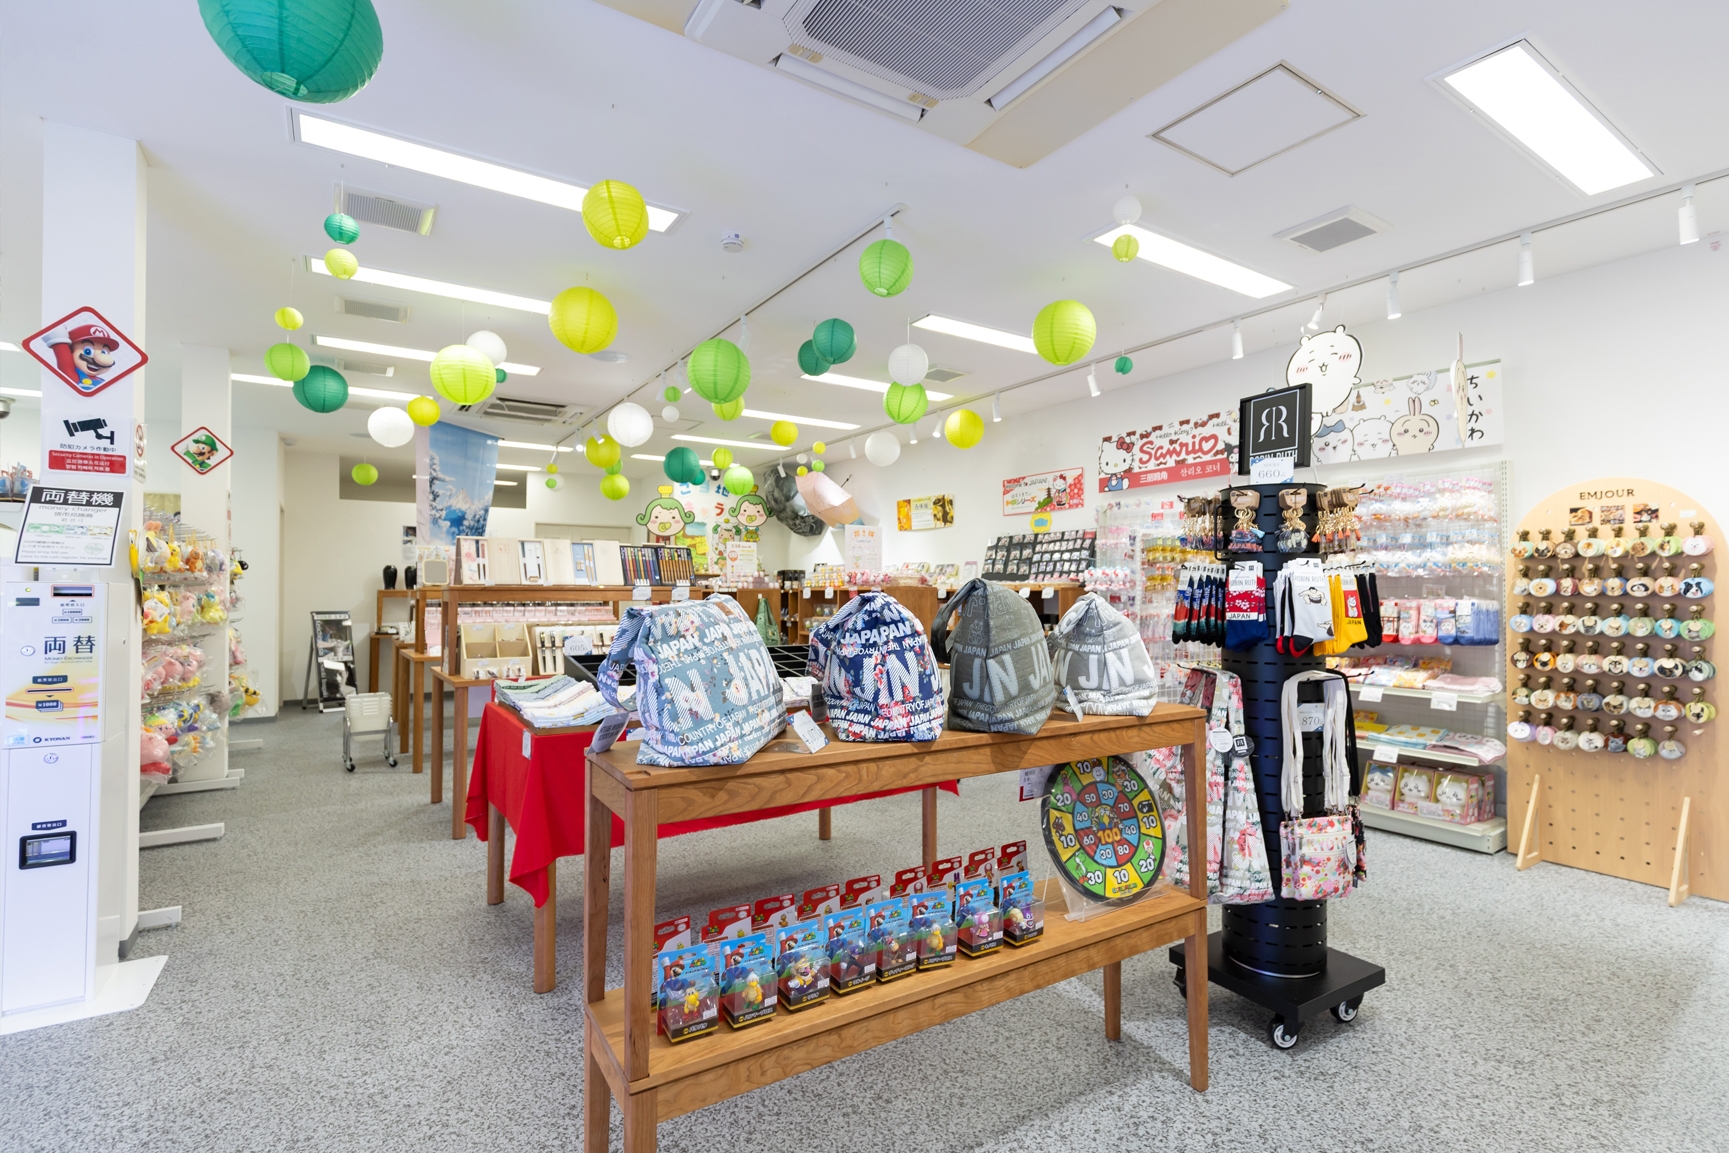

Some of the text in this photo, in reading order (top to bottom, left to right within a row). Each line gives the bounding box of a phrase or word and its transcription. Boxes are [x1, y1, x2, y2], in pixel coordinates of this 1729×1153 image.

[1467, 375, 1484, 441] ちいかわ
[1180, 462, 1220, 477] 산리오 코너
[41, 489, 114, 506] 両替機
[1579, 488, 1635, 500] EMJOUR
[44, 635, 96, 655] 両替
[657, 631, 703, 660] JAPAN
[964, 646, 987, 657] JAPAN
[989, 643, 1013, 657] JAPAN
[1079, 640, 1130, 654] JAPAN JAPAN
[1077, 761, 1091, 774] 10
[1123, 780, 1138, 792] 30
[1055, 793, 1071, 807] 20
[1085, 793, 1096, 803] 50
[1101, 790, 1114, 799] 30
[1118, 803, 1130, 813] 70
[1076, 812, 1088, 822] 40
[1142, 815, 1157, 829] 10
[1099, 829, 1121, 844] 100
[1125, 825, 1137, 835] 40
[1060, 834, 1076, 848] 10
[1083, 834, 1095, 845] 60
[1100, 849, 1112, 860] 30
[1117, 845, 1129, 855] 80
[1139, 859, 1154, 873] 20
[1087, 871, 1103, 885] 30
[1114, 869, 1129, 884] 10
